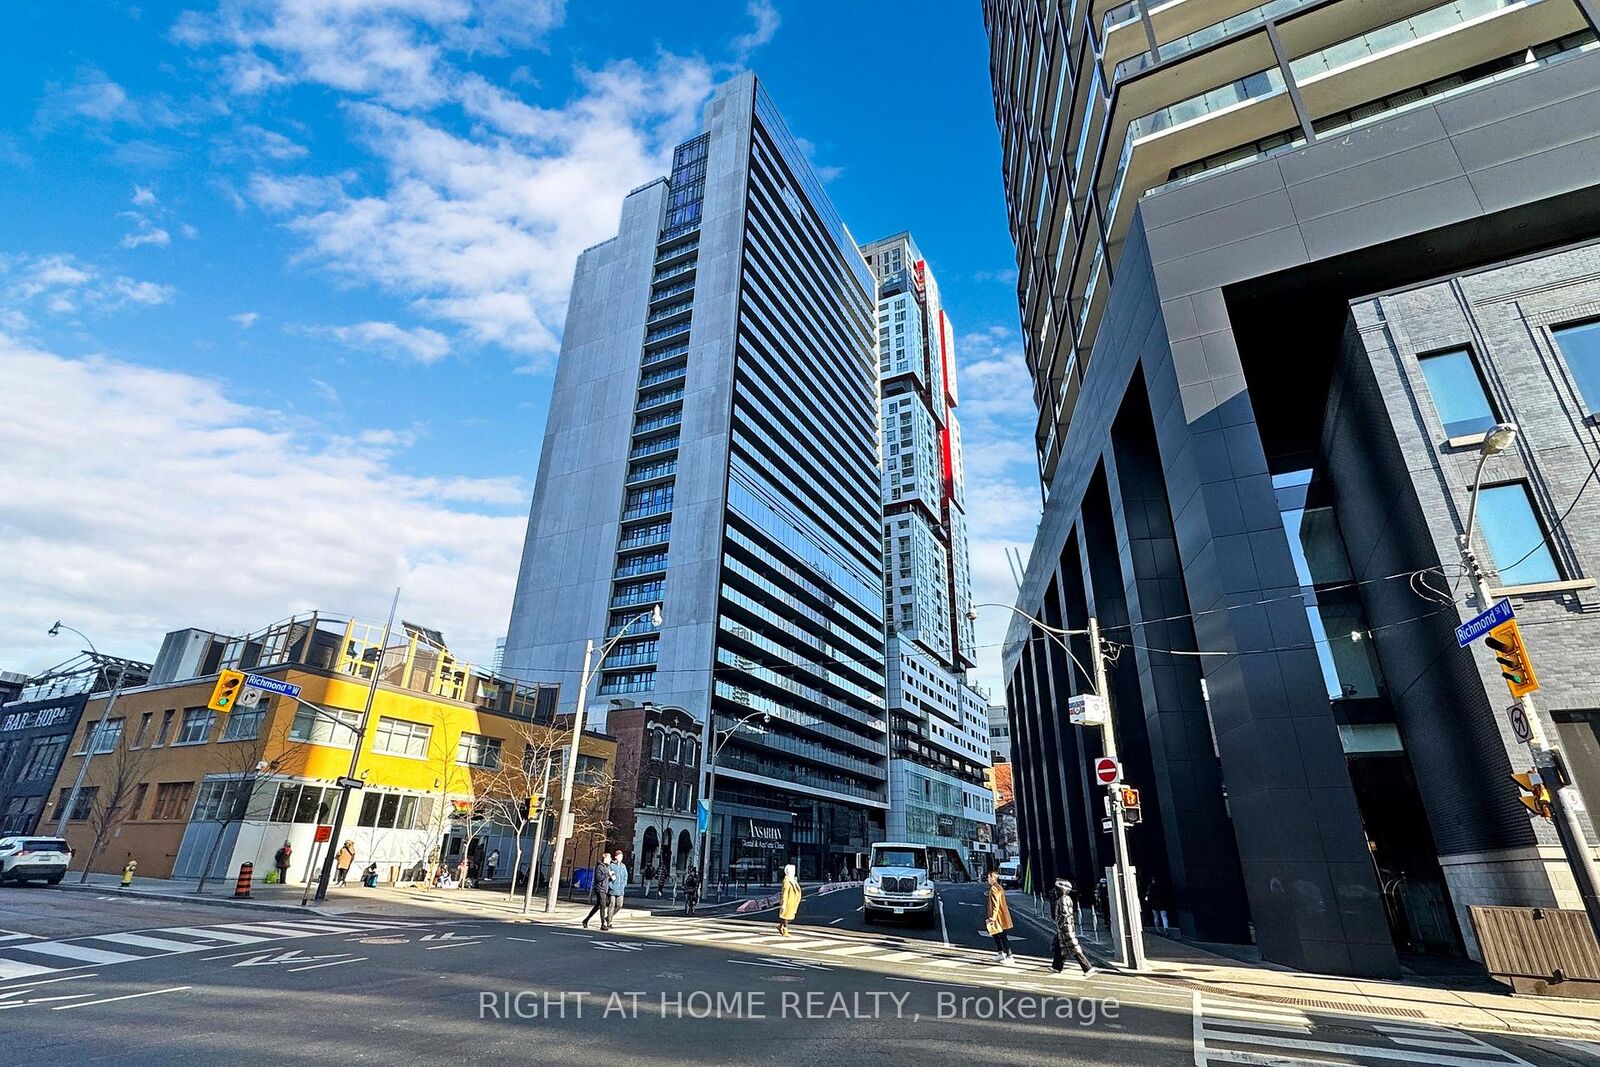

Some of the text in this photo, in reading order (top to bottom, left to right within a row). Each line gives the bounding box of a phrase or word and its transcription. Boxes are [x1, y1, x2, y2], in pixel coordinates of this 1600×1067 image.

[1457, 610, 1497, 642] Richmond
[1500, 600, 1511, 616] W
[248, 675, 287, 692] Richmond
[292, 686, 300, 695] W
[3, 712, 30, 732] BAR
[34, 707, 61, 727] HOP
